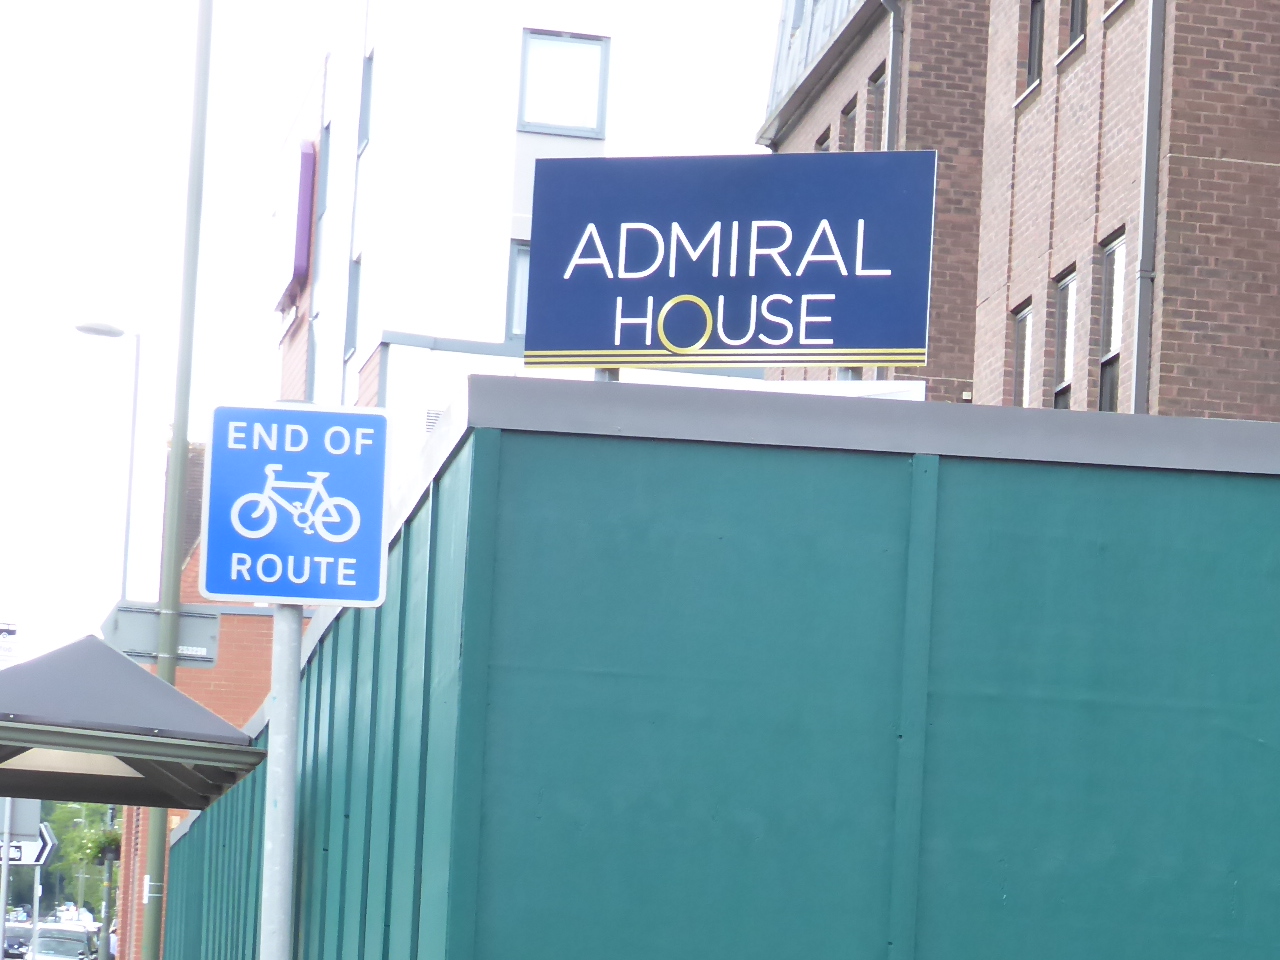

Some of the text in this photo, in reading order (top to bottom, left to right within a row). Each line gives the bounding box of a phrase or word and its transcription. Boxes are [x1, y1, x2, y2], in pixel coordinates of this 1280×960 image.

[563, 218, 892, 280] ADMIRAL
[614, 293, 836, 355] HOUSE
[227, 421, 375, 456] END OF
[230, 552, 357, 586] ROUTE
